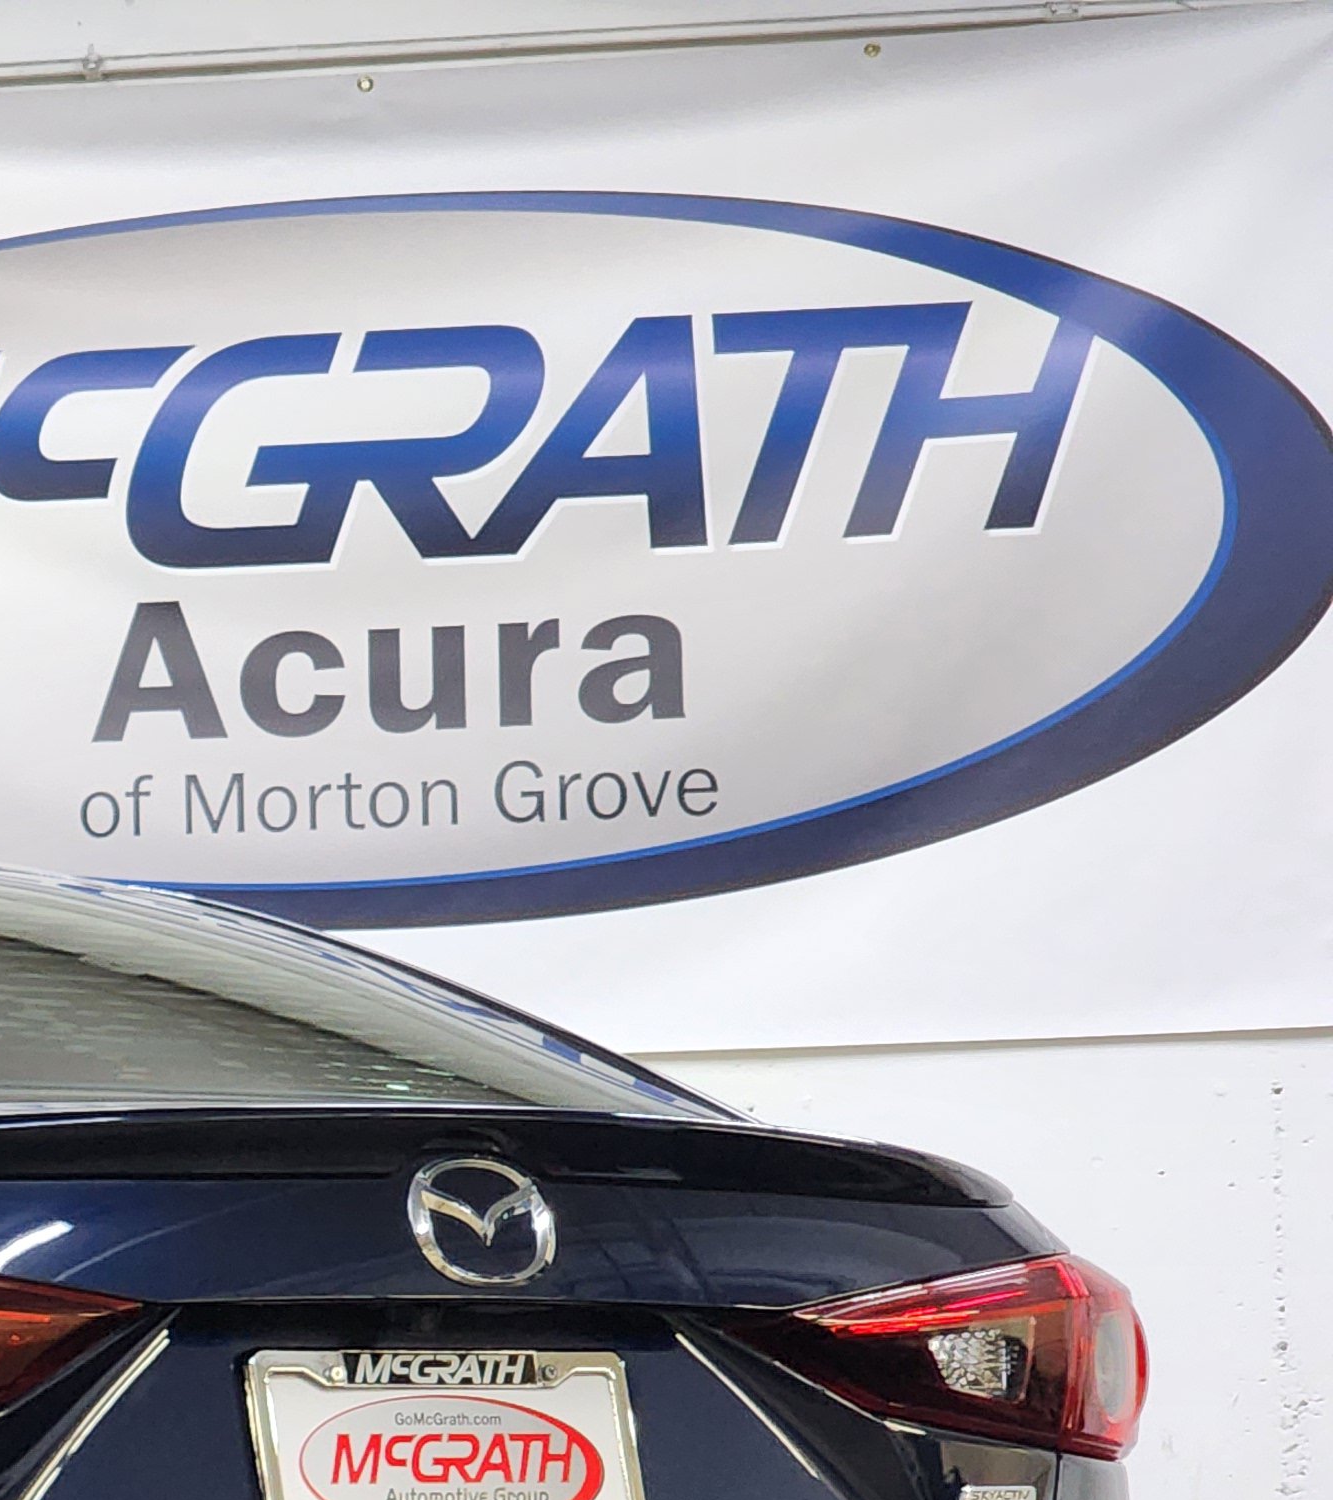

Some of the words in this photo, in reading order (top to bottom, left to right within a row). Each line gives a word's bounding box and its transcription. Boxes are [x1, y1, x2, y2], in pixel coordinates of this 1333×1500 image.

[91, 600, 685, 742] Acura
[79, 774, 153, 837] of
[183, 772, 459, 834] Morton
[494, 760, 719, 824] Grove
[394, 1412, 502, 1427] GoMcGrath.com
